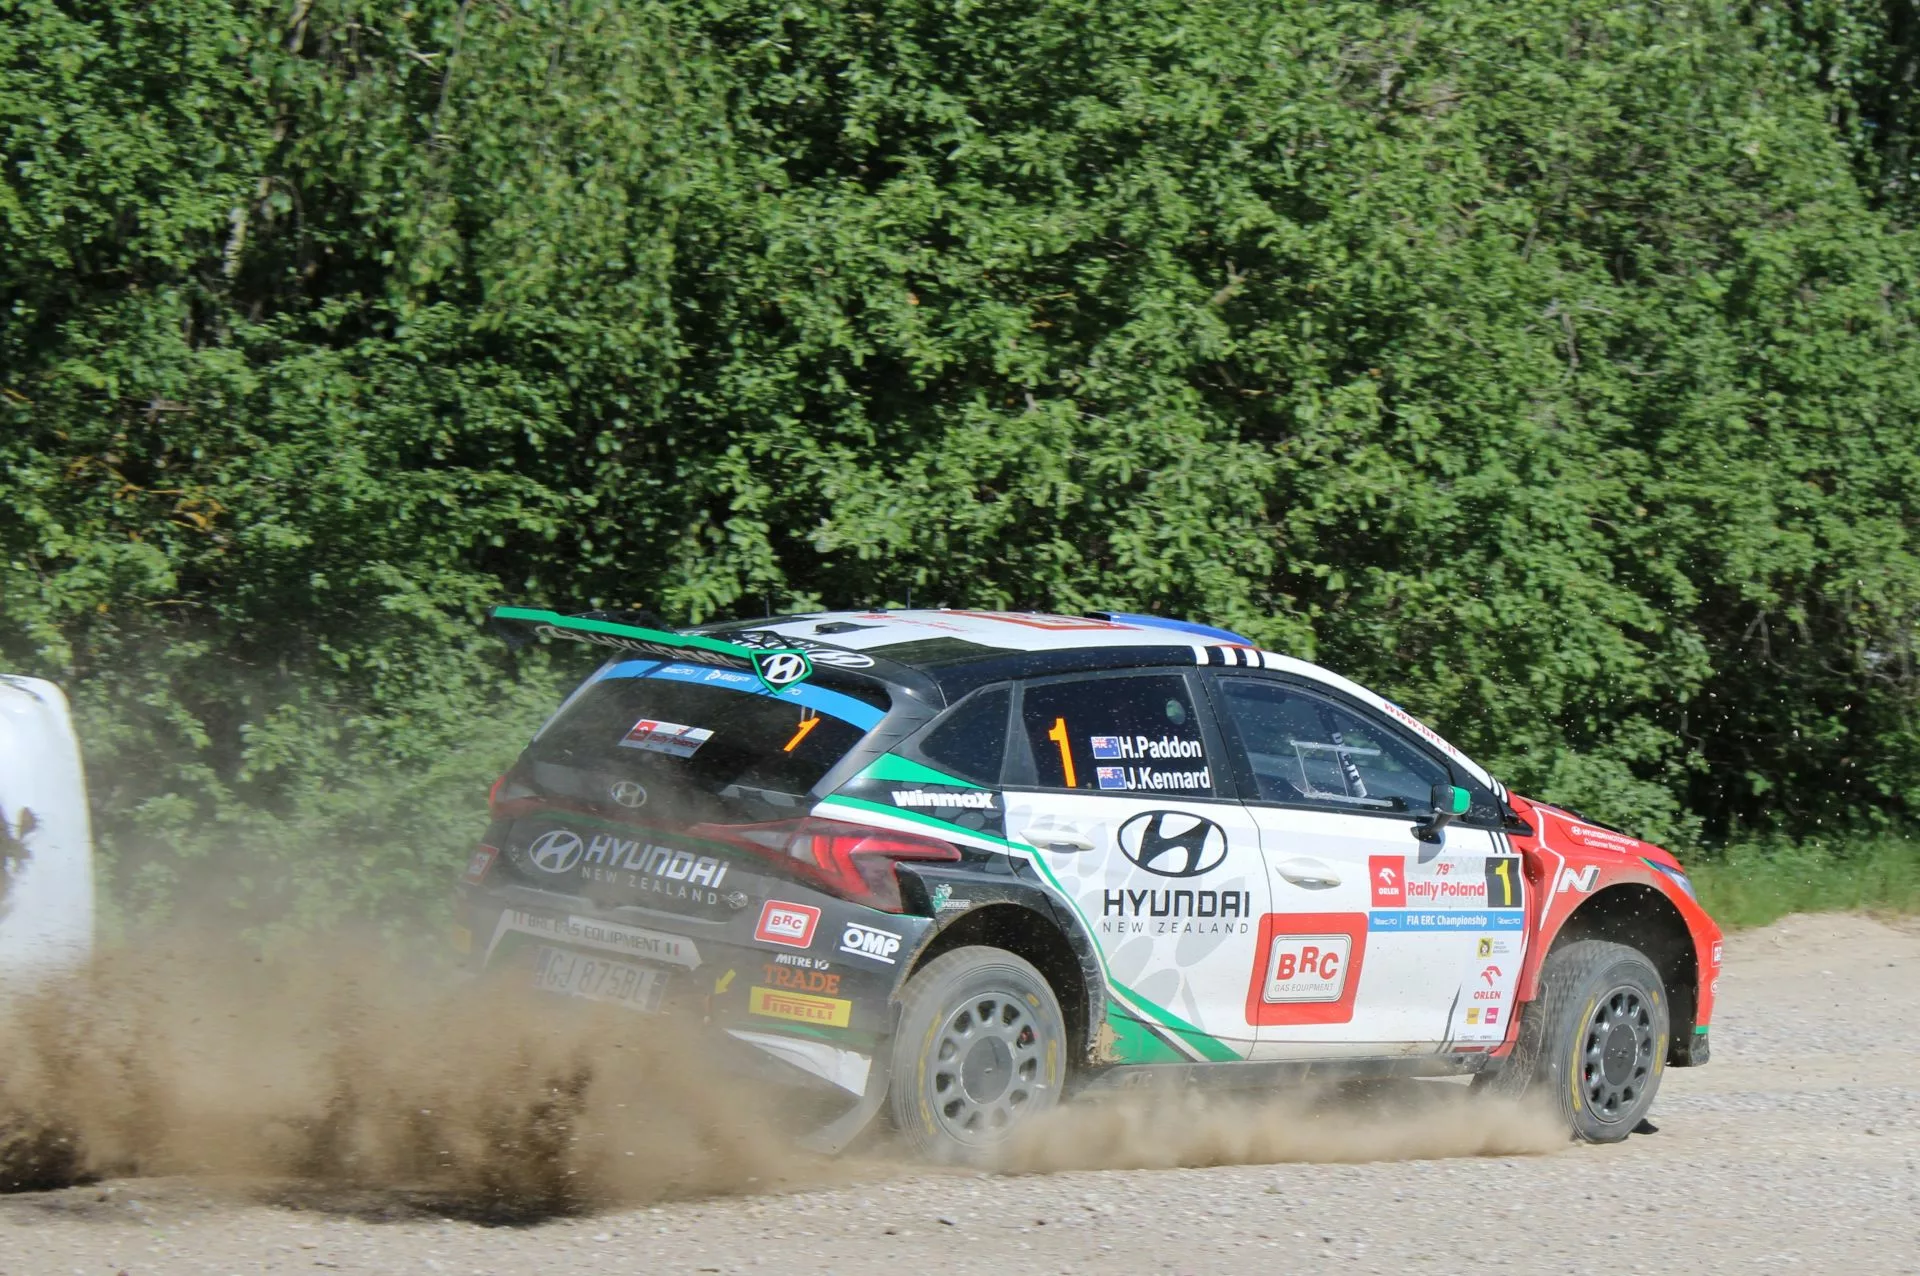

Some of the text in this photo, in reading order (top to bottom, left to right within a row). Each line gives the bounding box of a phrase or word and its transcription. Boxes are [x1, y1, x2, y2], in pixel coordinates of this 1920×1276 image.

[783, 717, 820, 752] 1
[1120, 734, 1203, 759] H.Paddon
[1048, 717, 1077, 787] 1
[1126, 766, 1211, 790] J.Kennard
[584, 835, 730, 889] HYUNDAI
[582, 867, 718, 905] NEW ZEALAND
[1378, 887, 1399, 896] ORLEN
[1408, 881, 1485, 900] Rally Poland
[1495, 859, 1511, 906] 1
[1103, 889, 1250, 917] HYUNDAI
[771, 915, 803, 930] BRC
[1102, 921, 1249, 934] NEW ZEALAND
[1407, 915, 1488, 928] FIA ERC Championship
[583, 924, 661, 953] EQUIPMENT
[842, 928, 900, 957] OMP
[775, 953, 812, 968] MITRE
[1276, 946, 1339, 980] BRC
[762, 963, 841, 995] TRADE
[1274, 983, 1334, 992] GAS EQUIPMENT
[762, 992, 836, 1020] PIRELLI
[1473, 991, 1502, 1000] ORLEN
